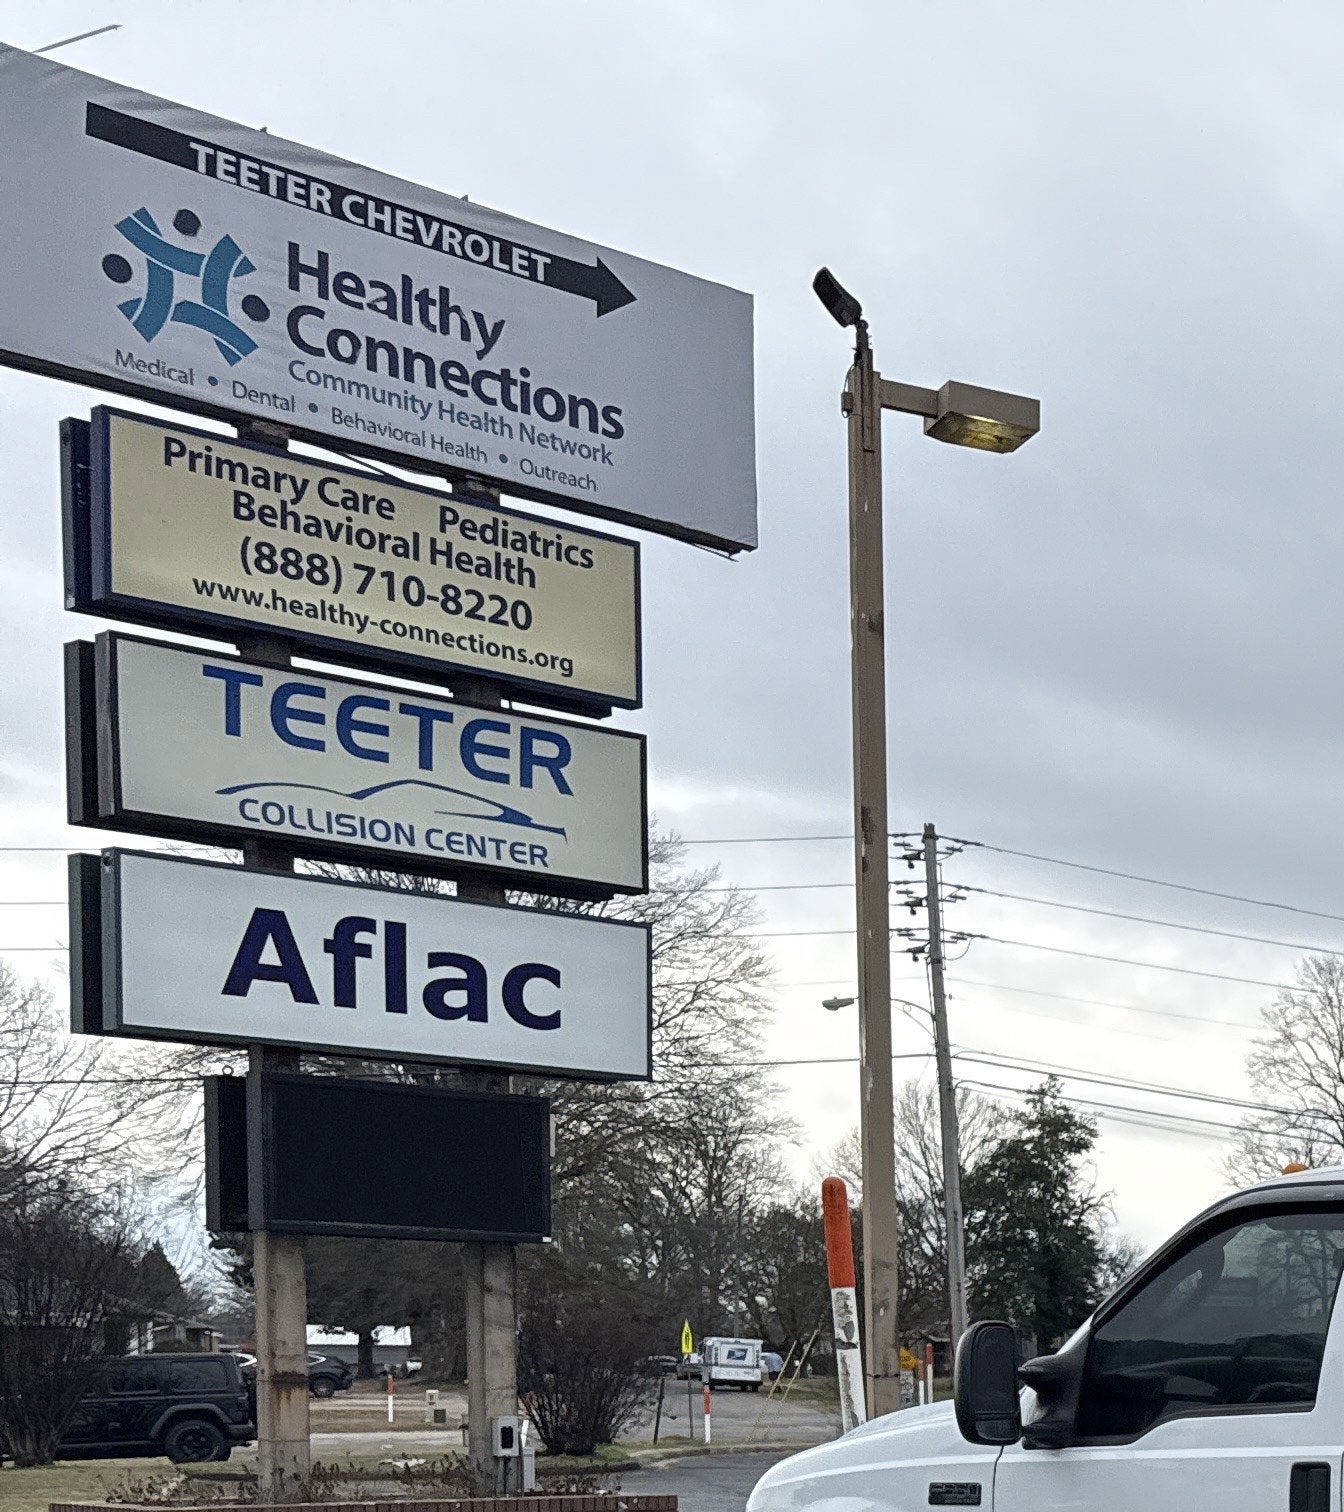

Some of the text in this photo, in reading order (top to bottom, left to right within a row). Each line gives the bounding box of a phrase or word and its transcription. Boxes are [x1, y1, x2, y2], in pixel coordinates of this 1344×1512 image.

[190, 141, 552, 282] TEETER CHEVROLET
[287, 241, 506, 360] Healthy
[115, 349, 598, 492] Medical Dental Behavioral Health Outreach
[286, 304, 625, 440] Connections
[288, 360, 614, 466] Community Health Network
[163, 436, 594, 569] Primary Care Pediatrics
[233, 489, 536, 588] Behavioral Health
[192, 578, 574, 678] www.healthy-connections.org
[240, 536, 533, 631] (888) 710-8220
[202, 664, 574, 797] TEETER
[239, 798, 549, 868] COLLISION CENTER
[221, 907, 562, 1031] Aflac
